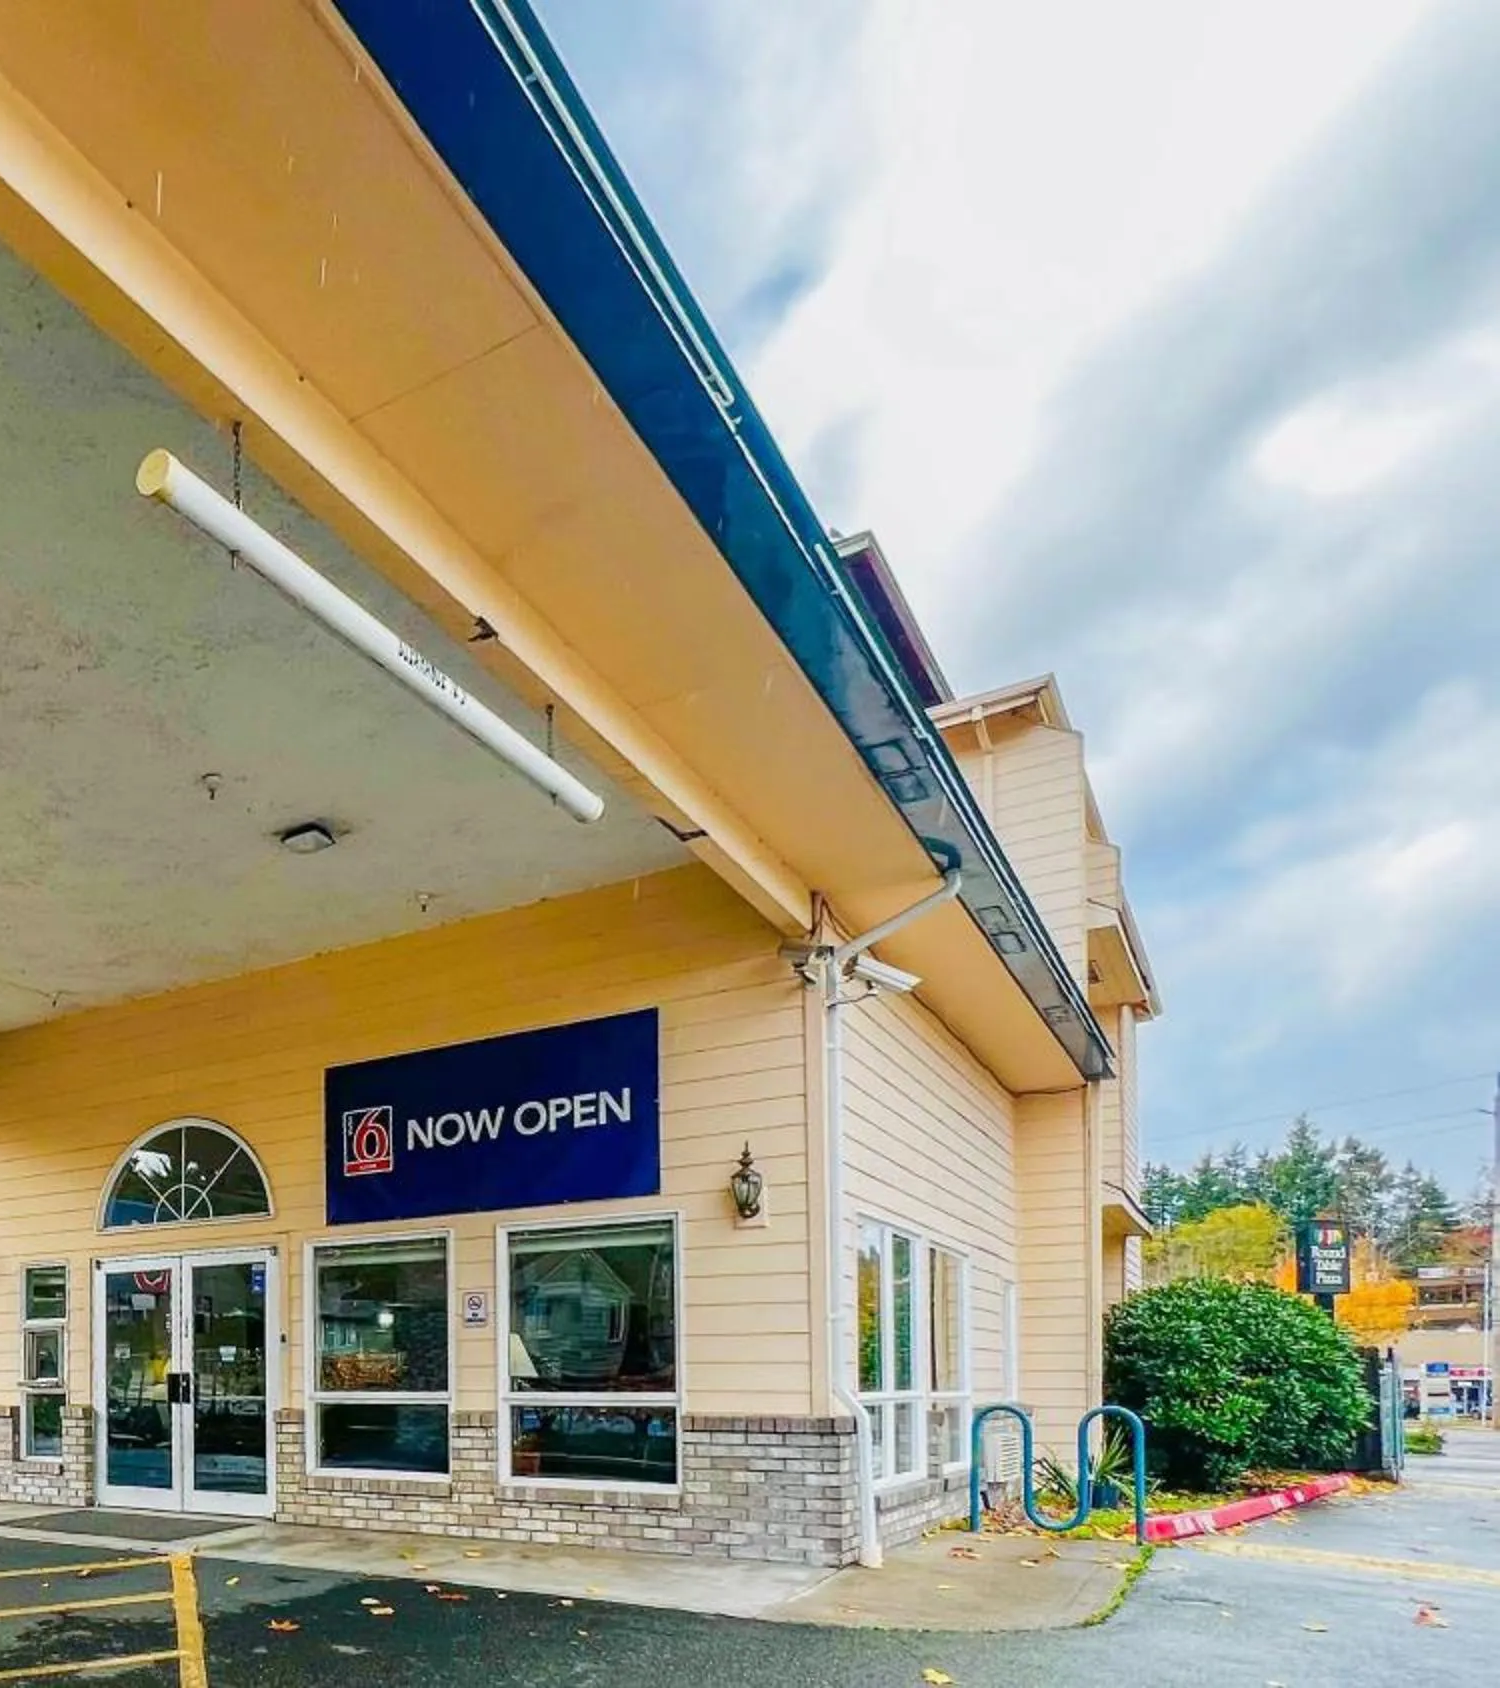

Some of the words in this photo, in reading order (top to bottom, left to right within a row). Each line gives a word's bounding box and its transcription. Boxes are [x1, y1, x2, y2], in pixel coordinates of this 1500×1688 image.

[353, 1107, 389, 1161] 6
[407, 1106, 505, 1150] NOW
[514, 1087, 631, 1135] OPEN
